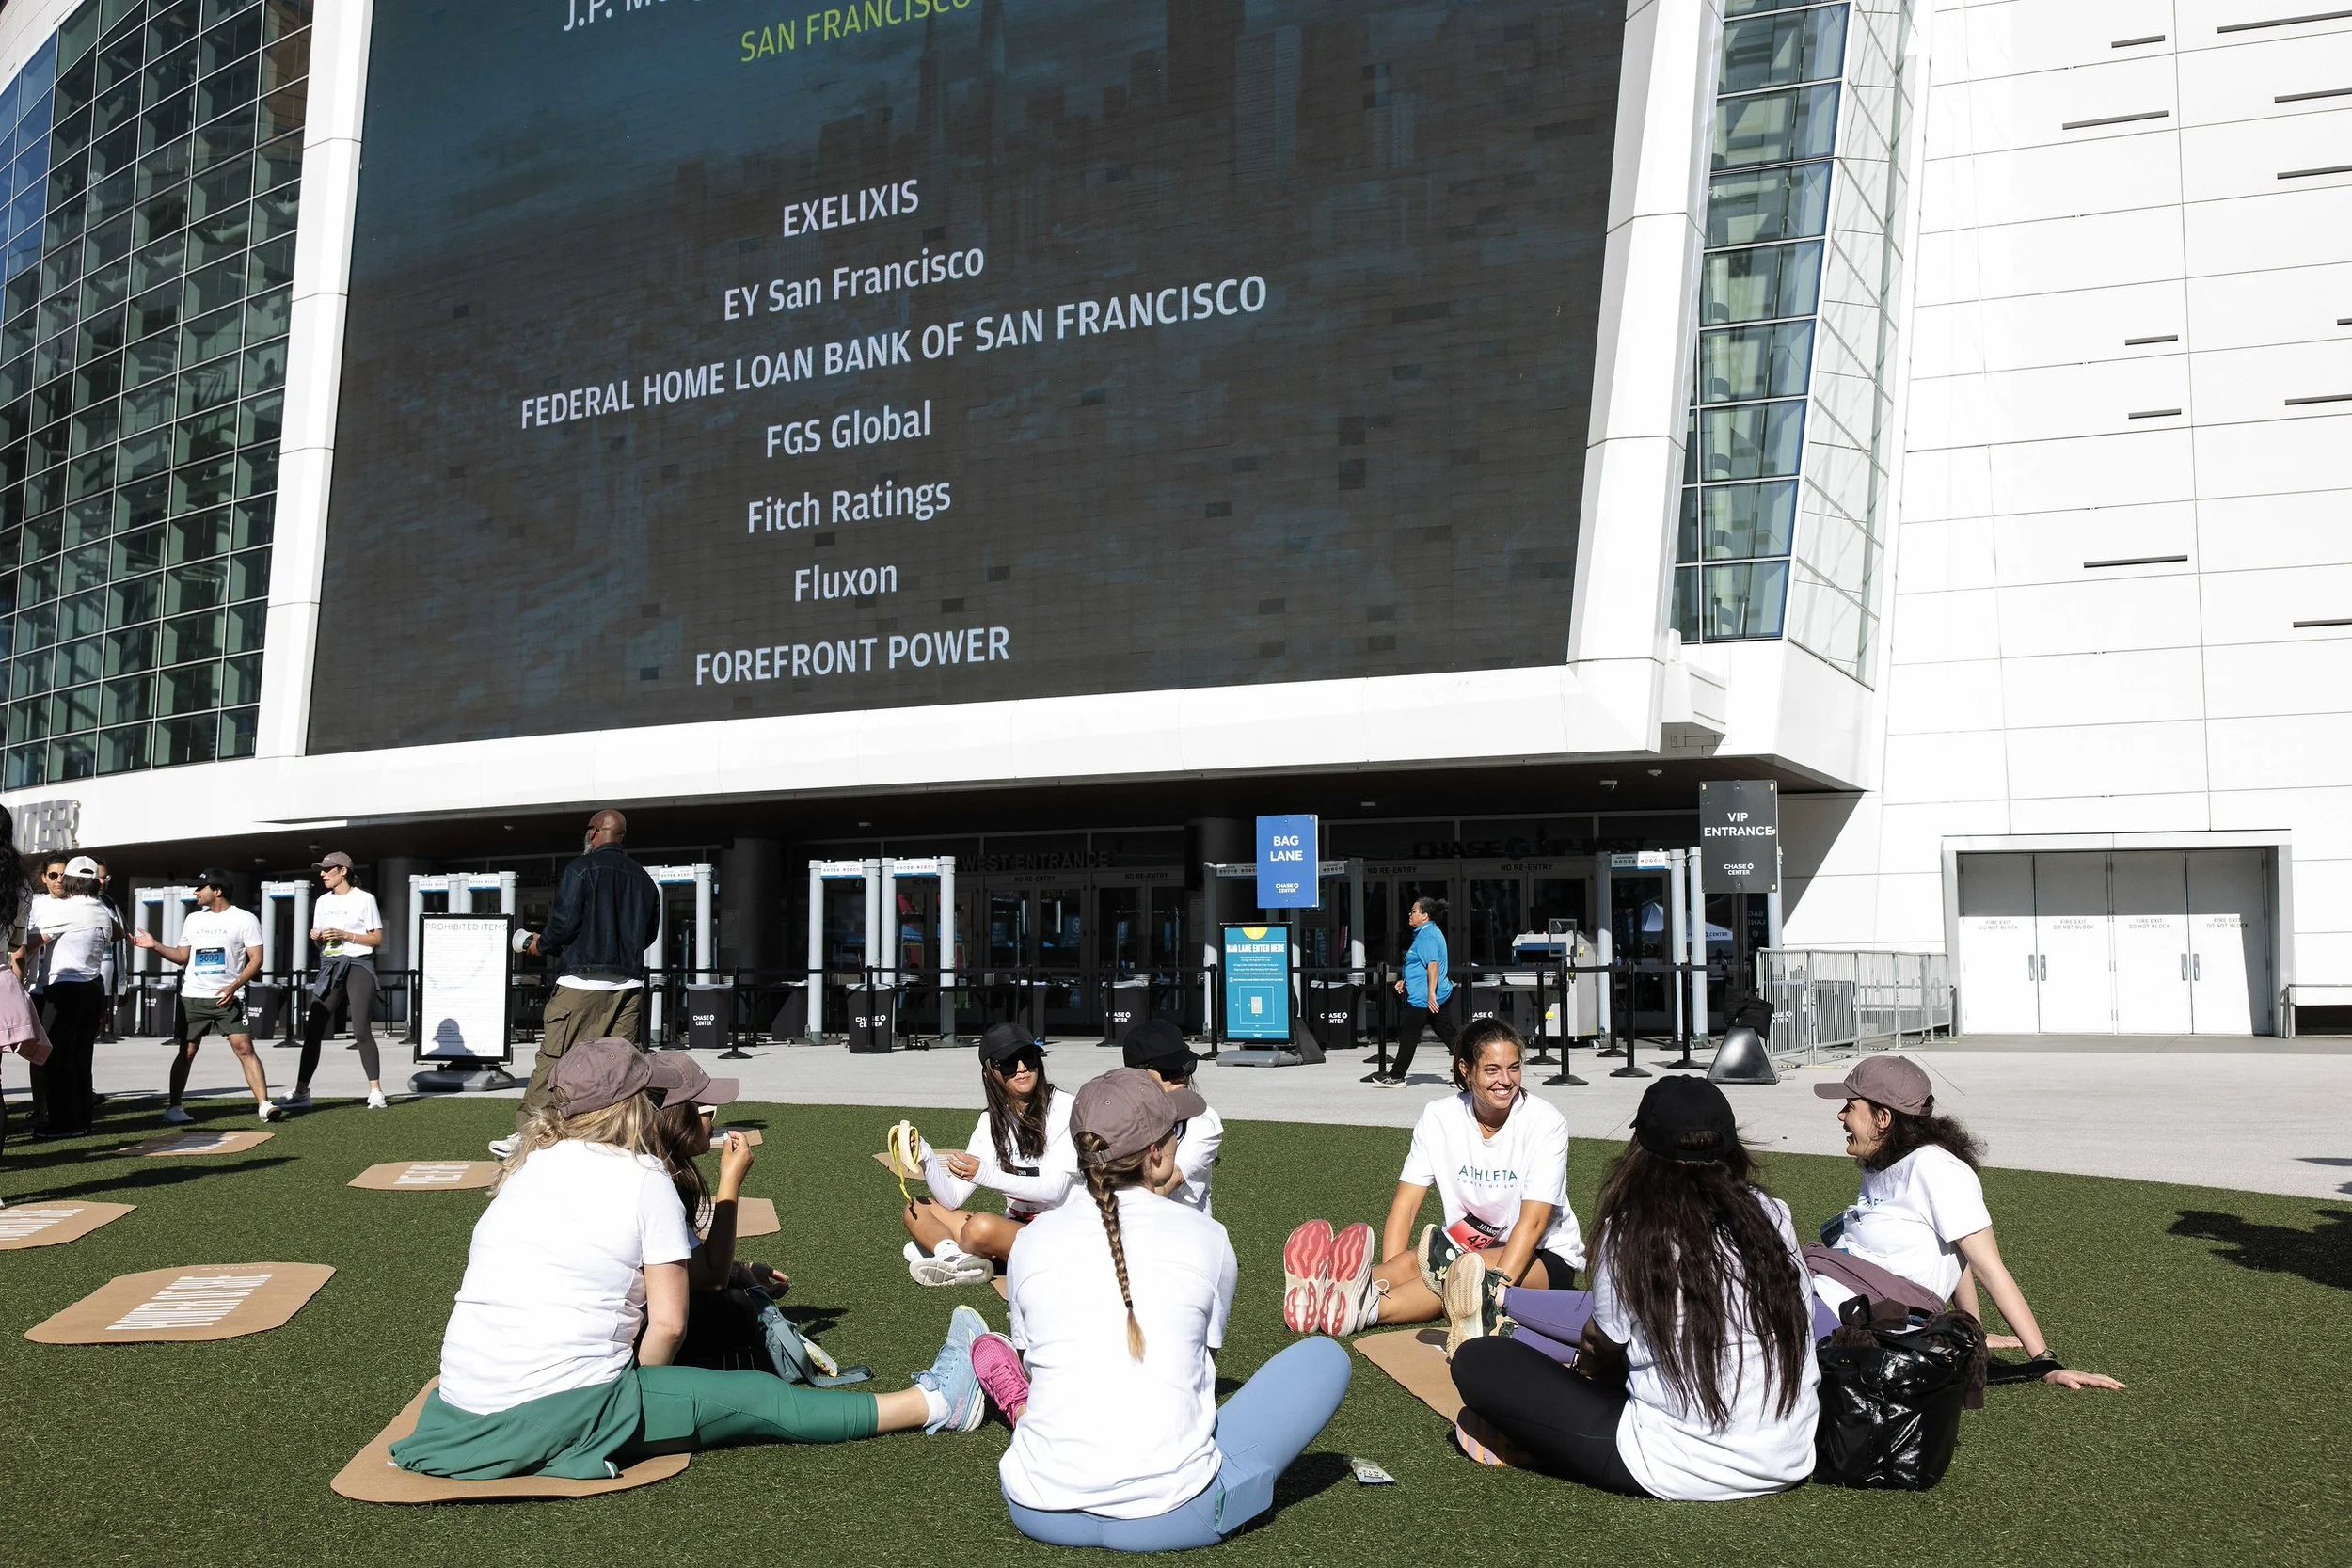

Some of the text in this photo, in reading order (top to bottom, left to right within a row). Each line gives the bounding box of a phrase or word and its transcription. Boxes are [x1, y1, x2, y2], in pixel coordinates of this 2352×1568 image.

[740, 0, 971, 62] SAN FRANCIS
[784, 179, 920, 237] EXELIXIS
[724, 247, 984, 321] EY San Francisco
[521, 275, 1266, 429] FEDERAL HOME LOAN BANK OF SAN FRANCISCO
[767, 399, 930, 458] FGS Global
[748, 480, 951, 533] Fitch Ratings
[795, 564, 897, 602] Fluxon
[696, 626, 1009, 687] FOREFRONT POWER
[1704, 826, 1773, 837] ENTRANCE
[1727, 812, 1749, 822] VIP
[1270, 850, 1303, 862] LANE
[1273, 835, 1299, 847] BAG
[961, 850, 1109, 872] WEST ENTRANCE
[1501, 863, 1553, 872] NO RE-ENTRY
[199, 954, 219, 962] 5690
[1458, 1164, 1518, 1182] ATHLETA
